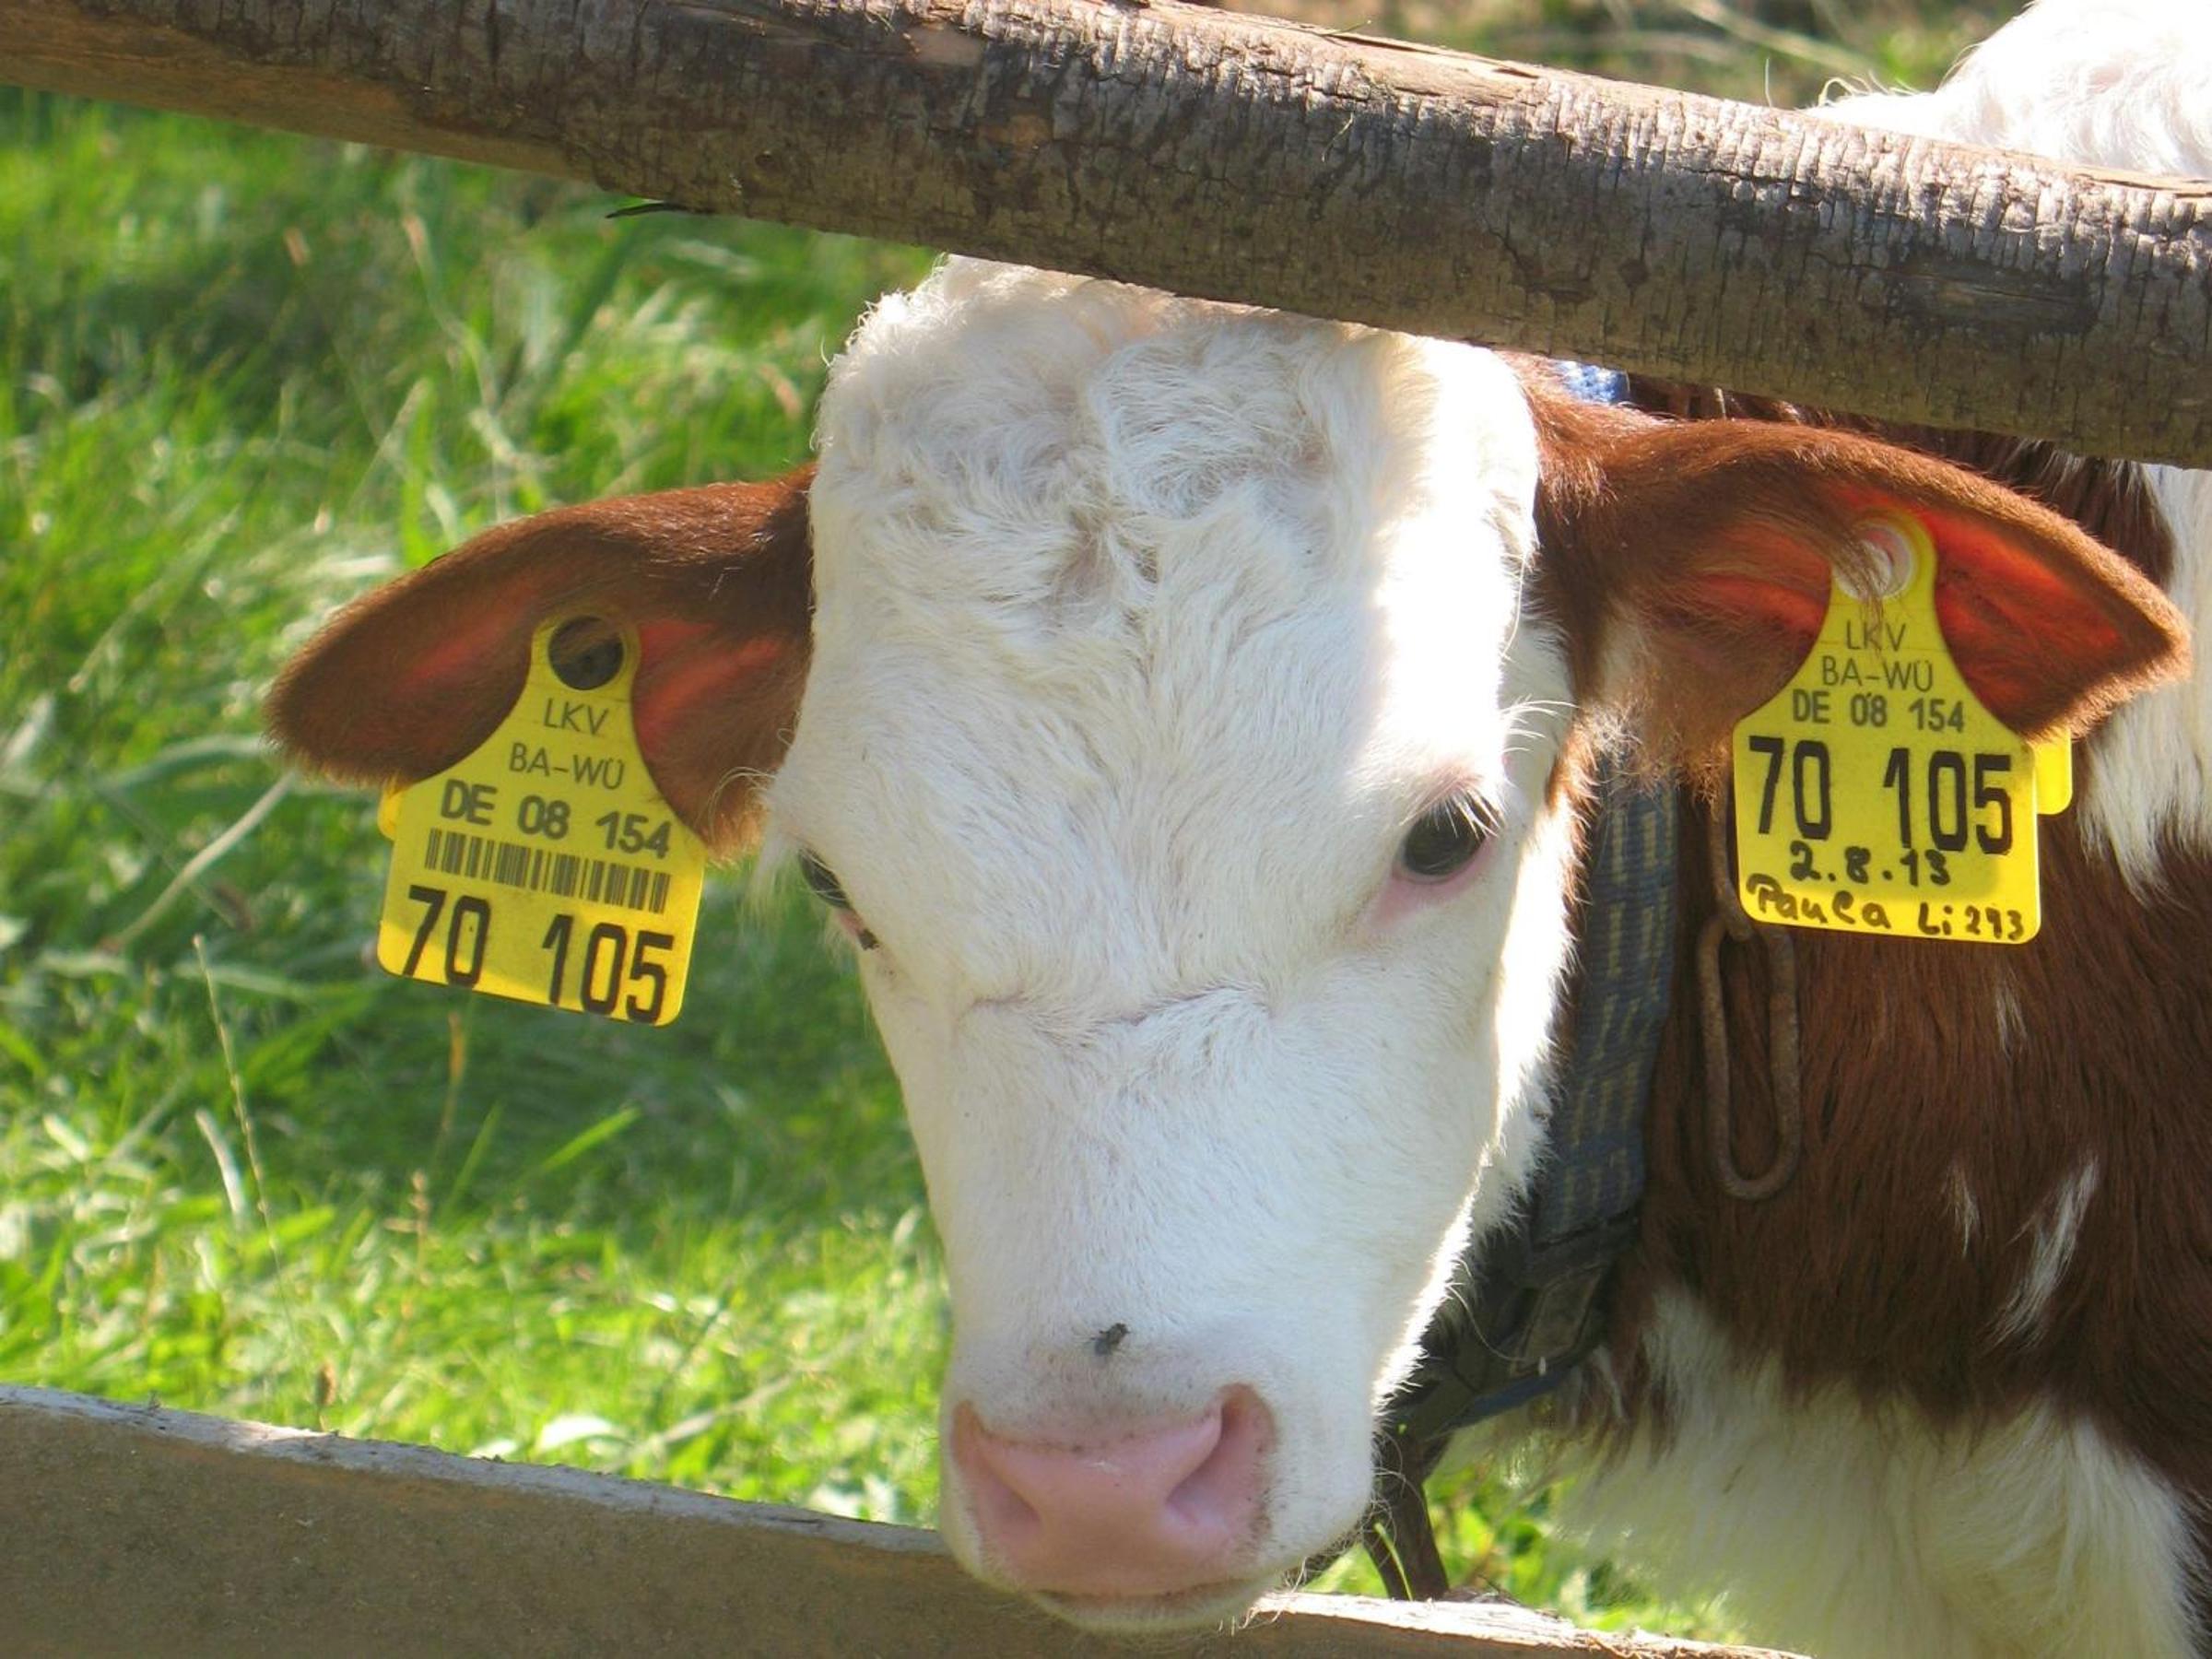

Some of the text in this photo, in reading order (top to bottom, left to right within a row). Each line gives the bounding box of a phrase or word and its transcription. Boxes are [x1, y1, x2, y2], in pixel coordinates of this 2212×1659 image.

[1846, 620, 1906, 651] LKV
[1822, 655, 1934, 691] BA-WÜ
[544, 699, 608, 735] LKV
[1793, 688, 1965, 733] DE 08 154
[509, 741, 625, 790] BA-WÜ
[1748, 735, 2013, 855] 70 105
[441, 779, 672, 860] DE 08 154
[402, 885, 675, 1025] 70 105
